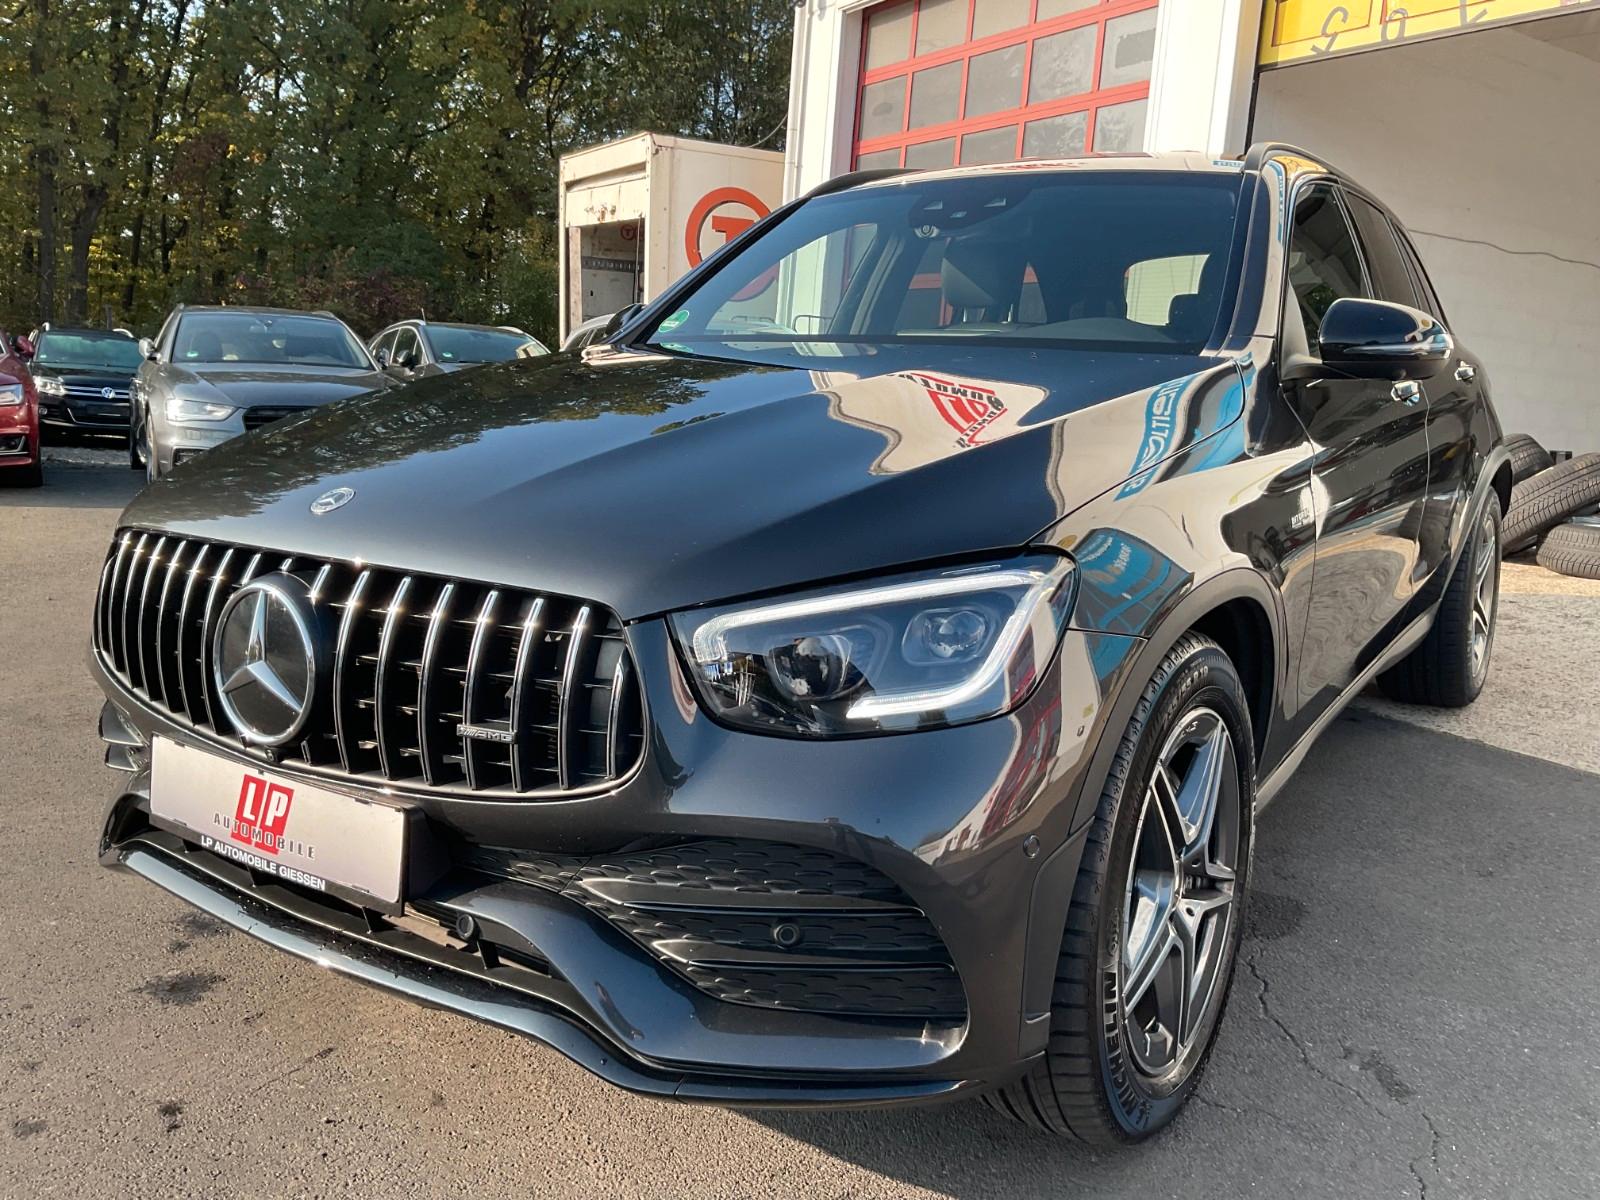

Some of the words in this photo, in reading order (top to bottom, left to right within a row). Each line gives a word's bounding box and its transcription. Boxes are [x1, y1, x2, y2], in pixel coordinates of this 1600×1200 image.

[475, 731, 512, 742] AMG
[243, 782, 288, 826] LP
[213, 812, 316, 860] AUTOMOBILE
[201, 835, 214, 848] LP
[214, 842, 277, 874] AUTOMOBILE
[279, 864, 326, 891] GIESSEN
[1103, 970, 1138, 1117] MICHELIN
